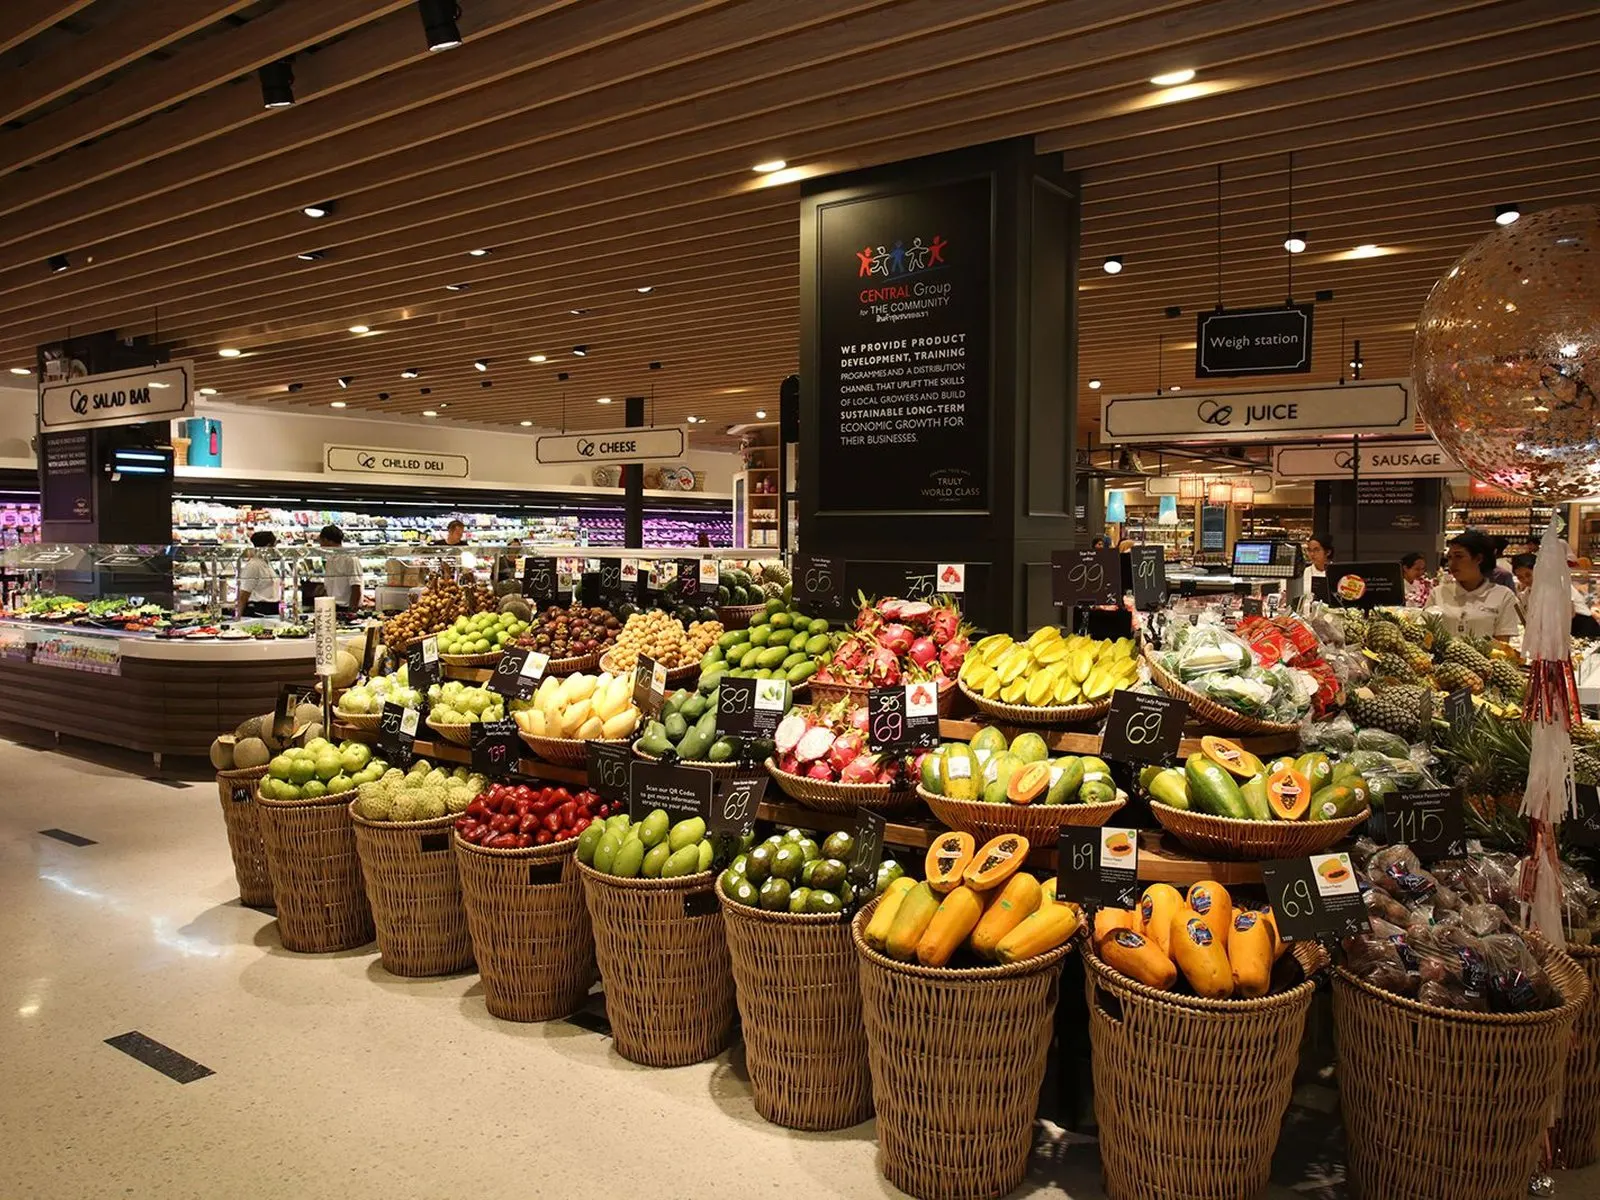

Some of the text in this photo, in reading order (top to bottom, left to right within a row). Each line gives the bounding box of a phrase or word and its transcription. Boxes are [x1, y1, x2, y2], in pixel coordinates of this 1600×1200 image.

[860, 281, 952, 304] CENTRAL Group
[870, 304, 889, 314] THE
[890, 296, 951, 312] COMMUNITY
[840, 333, 967, 354] WE PROVIDE PRODUCT
[1210, 333, 1298, 350] Weigh station
[841, 347, 966, 368] DEVELOPMENT, TRAINING
[841, 362, 965, 381] PROGRAMMES AND A DISTRIBUTION
[841, 376, 965, 394] CHANNEL THAT UPLIFT THE SKILLS
[93, 388, 151, 409] SALAD BAR
[840, 390, 966, 407] OF LOCAL GROWERS AND BUILD
[840, 403, 965, 420] SUSTAINABLE LONG-TERM
[1244, 404, 1298, 425] JUICE
[840, 416, 964, 433] ECONOMIC GROWTH FOR
[600, 441, 636, 453] CHEESE
[840, 435, 866, 445] THEIR
[382, 458, 444, 470] CHILLED DELI
[1372, 453, 1441, 466] SAUSAGE
[937, 477, 963, 486] TRULY
[920, 487, 981, 497] WORLD CLASS
[529, 568, 551, 590] 75
[905, 574, 936, 600] 75
[381, 711, 402, 733] 75
[873, 712, 902, 742] 69
[646, 784, 658, 792] Scan
[669, 787, 678, 795] QR
[678, 789, 695, 797] Codes
[671, 796, 700, 804] information
[1393, 809, 1445, 844] 115
[1282, 879, 1314, 918] 69
